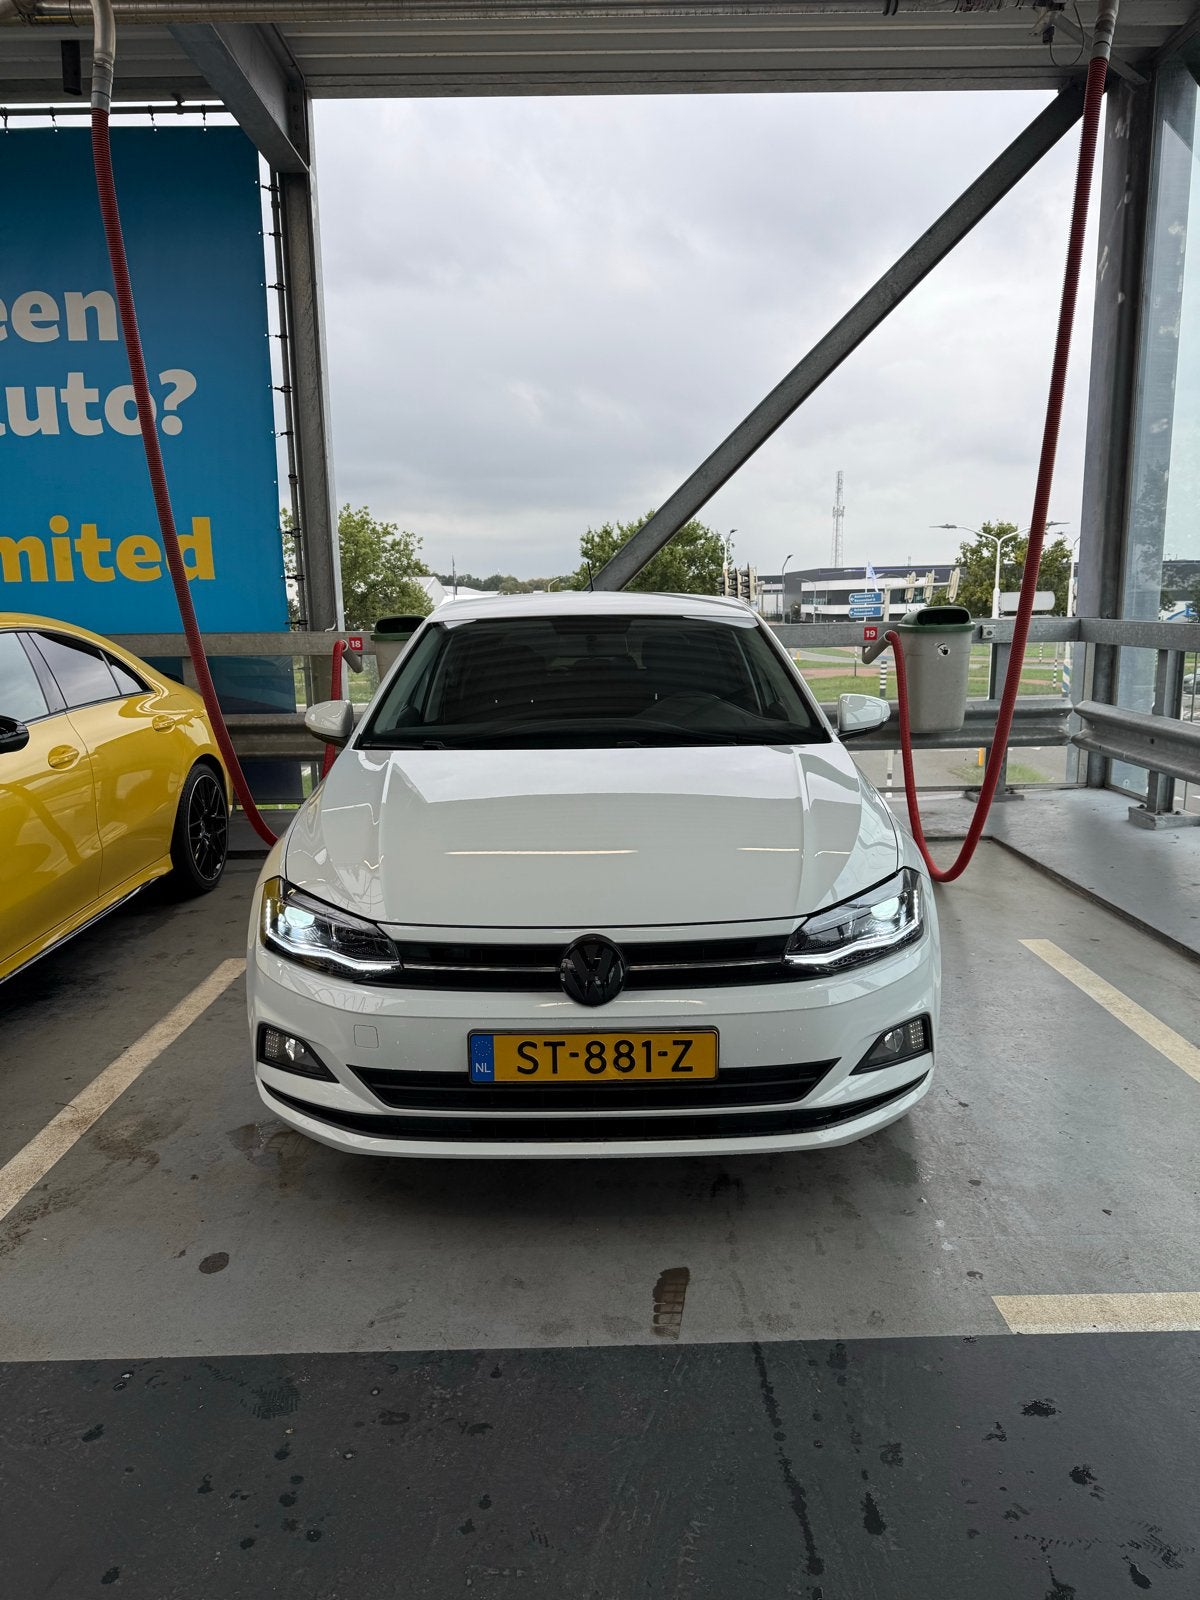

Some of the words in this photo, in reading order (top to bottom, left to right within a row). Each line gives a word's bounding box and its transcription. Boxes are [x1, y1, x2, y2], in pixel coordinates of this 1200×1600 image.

[0, 290, 119, 343] en
[0, 369, 197, 436] uto?
[350, 640, 361, 648] 18
[865, 630, 876, 638] 19
[560, 937, 625, 1005] VW
[475, 1062, 492, 1073] NL
[516, 1039, 694, 1075] ST-881-Z
